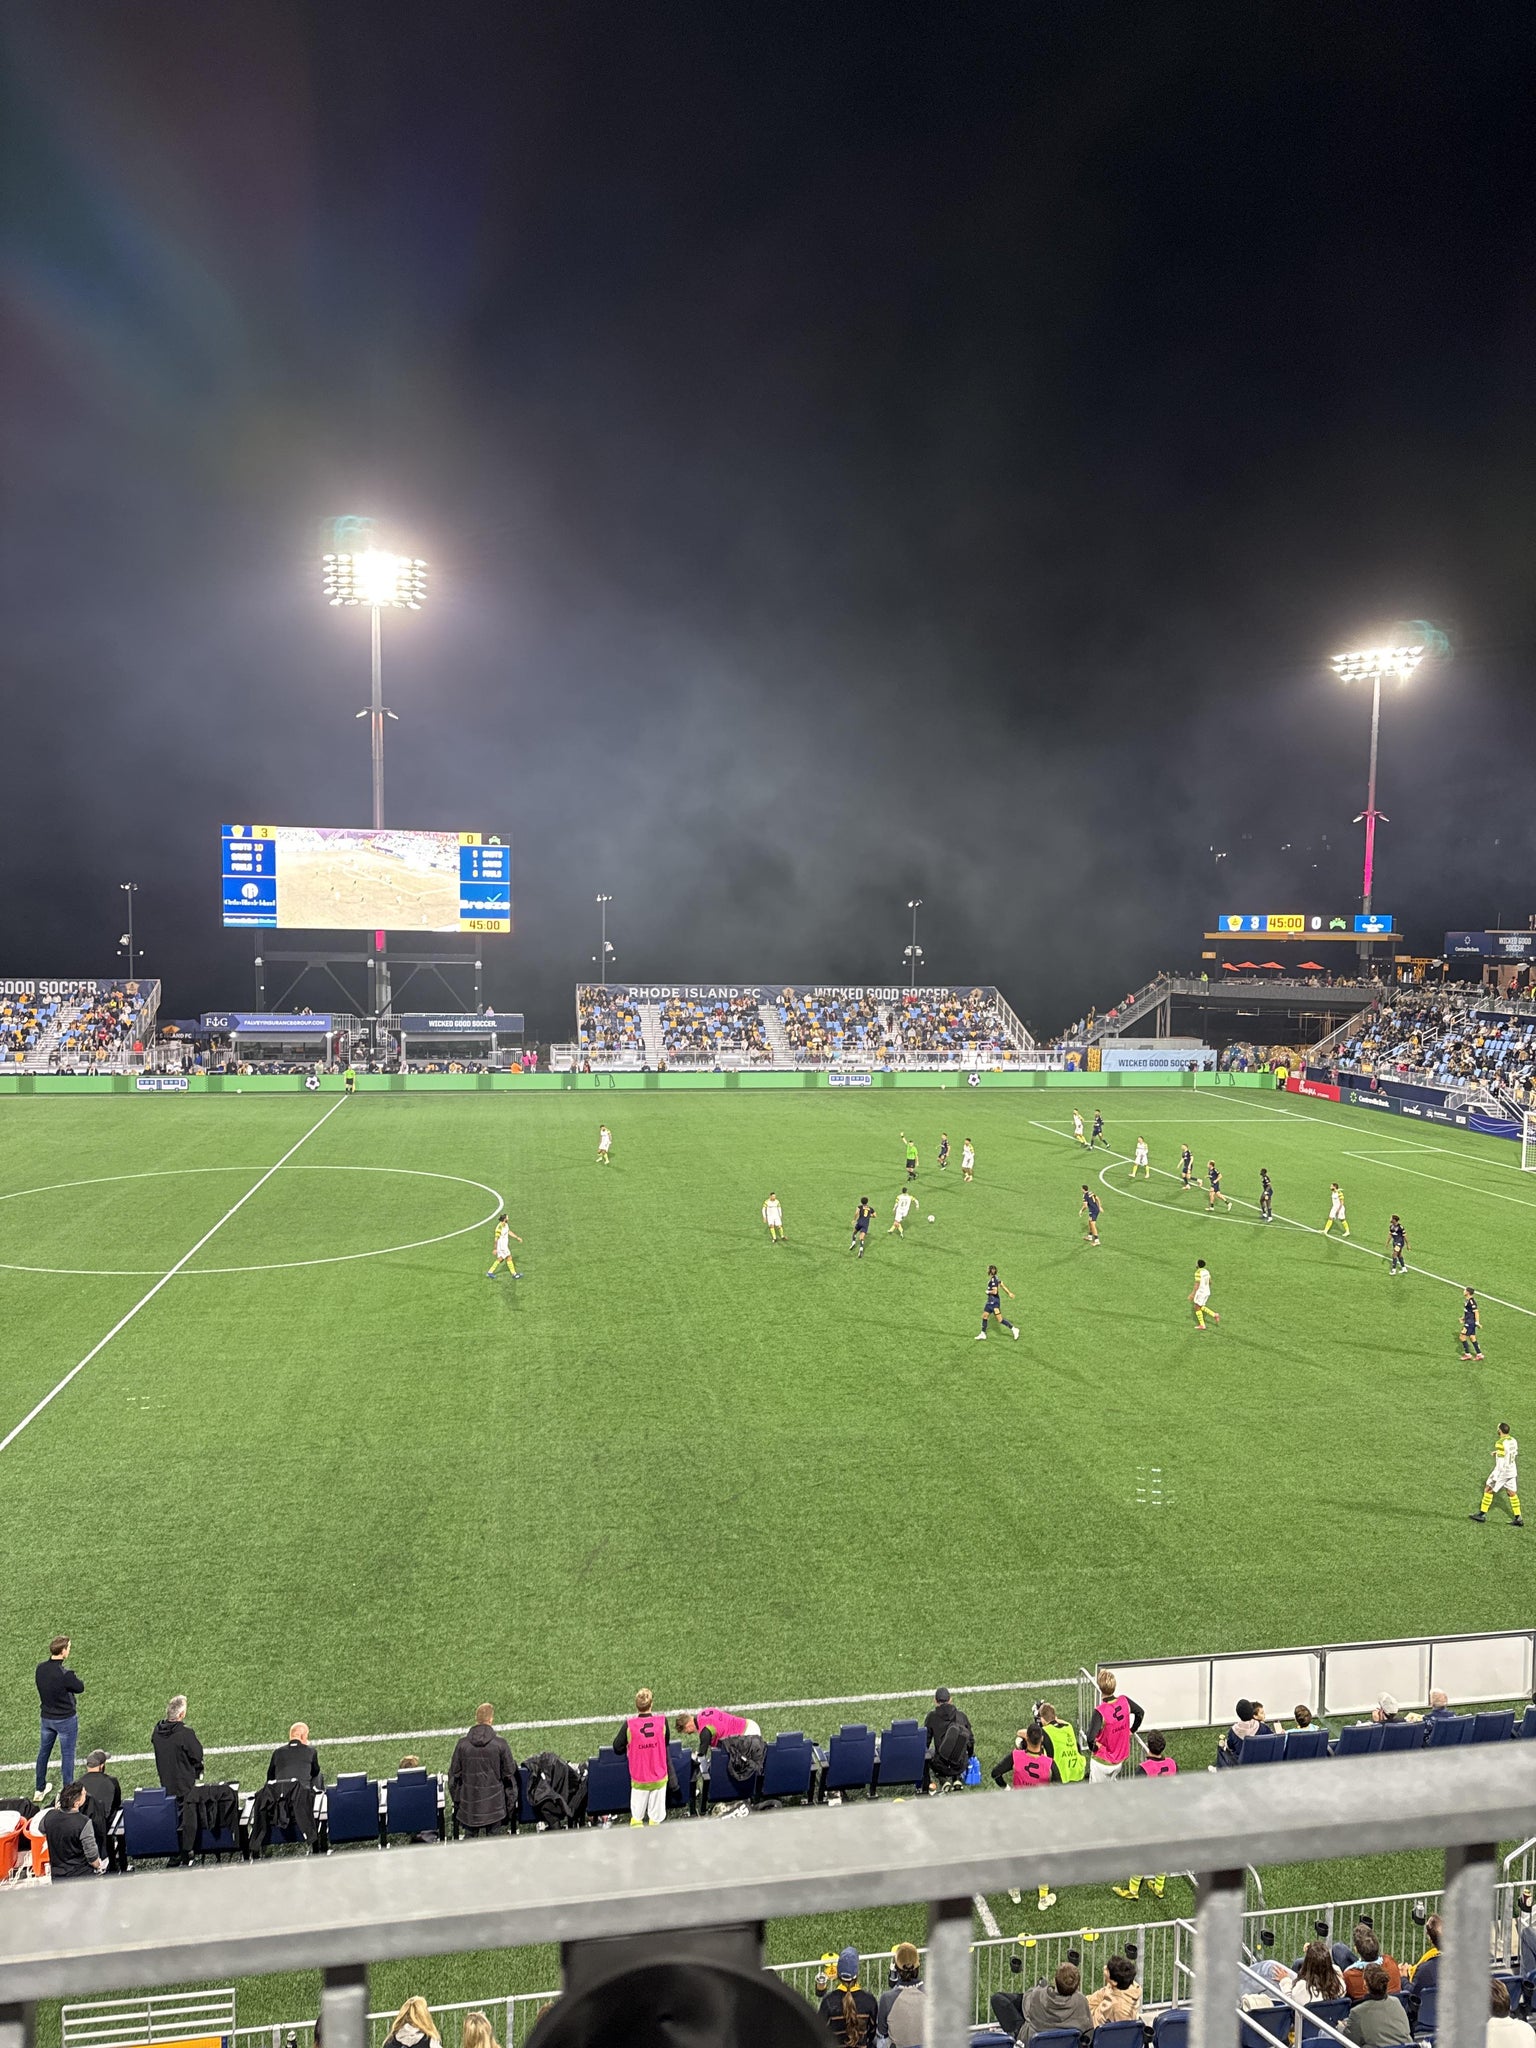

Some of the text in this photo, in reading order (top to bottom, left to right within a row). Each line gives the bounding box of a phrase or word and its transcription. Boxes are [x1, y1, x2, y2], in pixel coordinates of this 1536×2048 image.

[261, 828, 268, 838] 3
[467, 835, 474, 844] 0
[469, 920, 500, 930] 45:00
[1250, 916, 1321, 930] 3 45:00 0
[629, 987, 761, 998] RHODE ISLAND FC
[814, 987, 863, 1000] WICKED
[866, 988, 899, 1001] GOOD
[1067, 1758, 1078, 1768] 17
